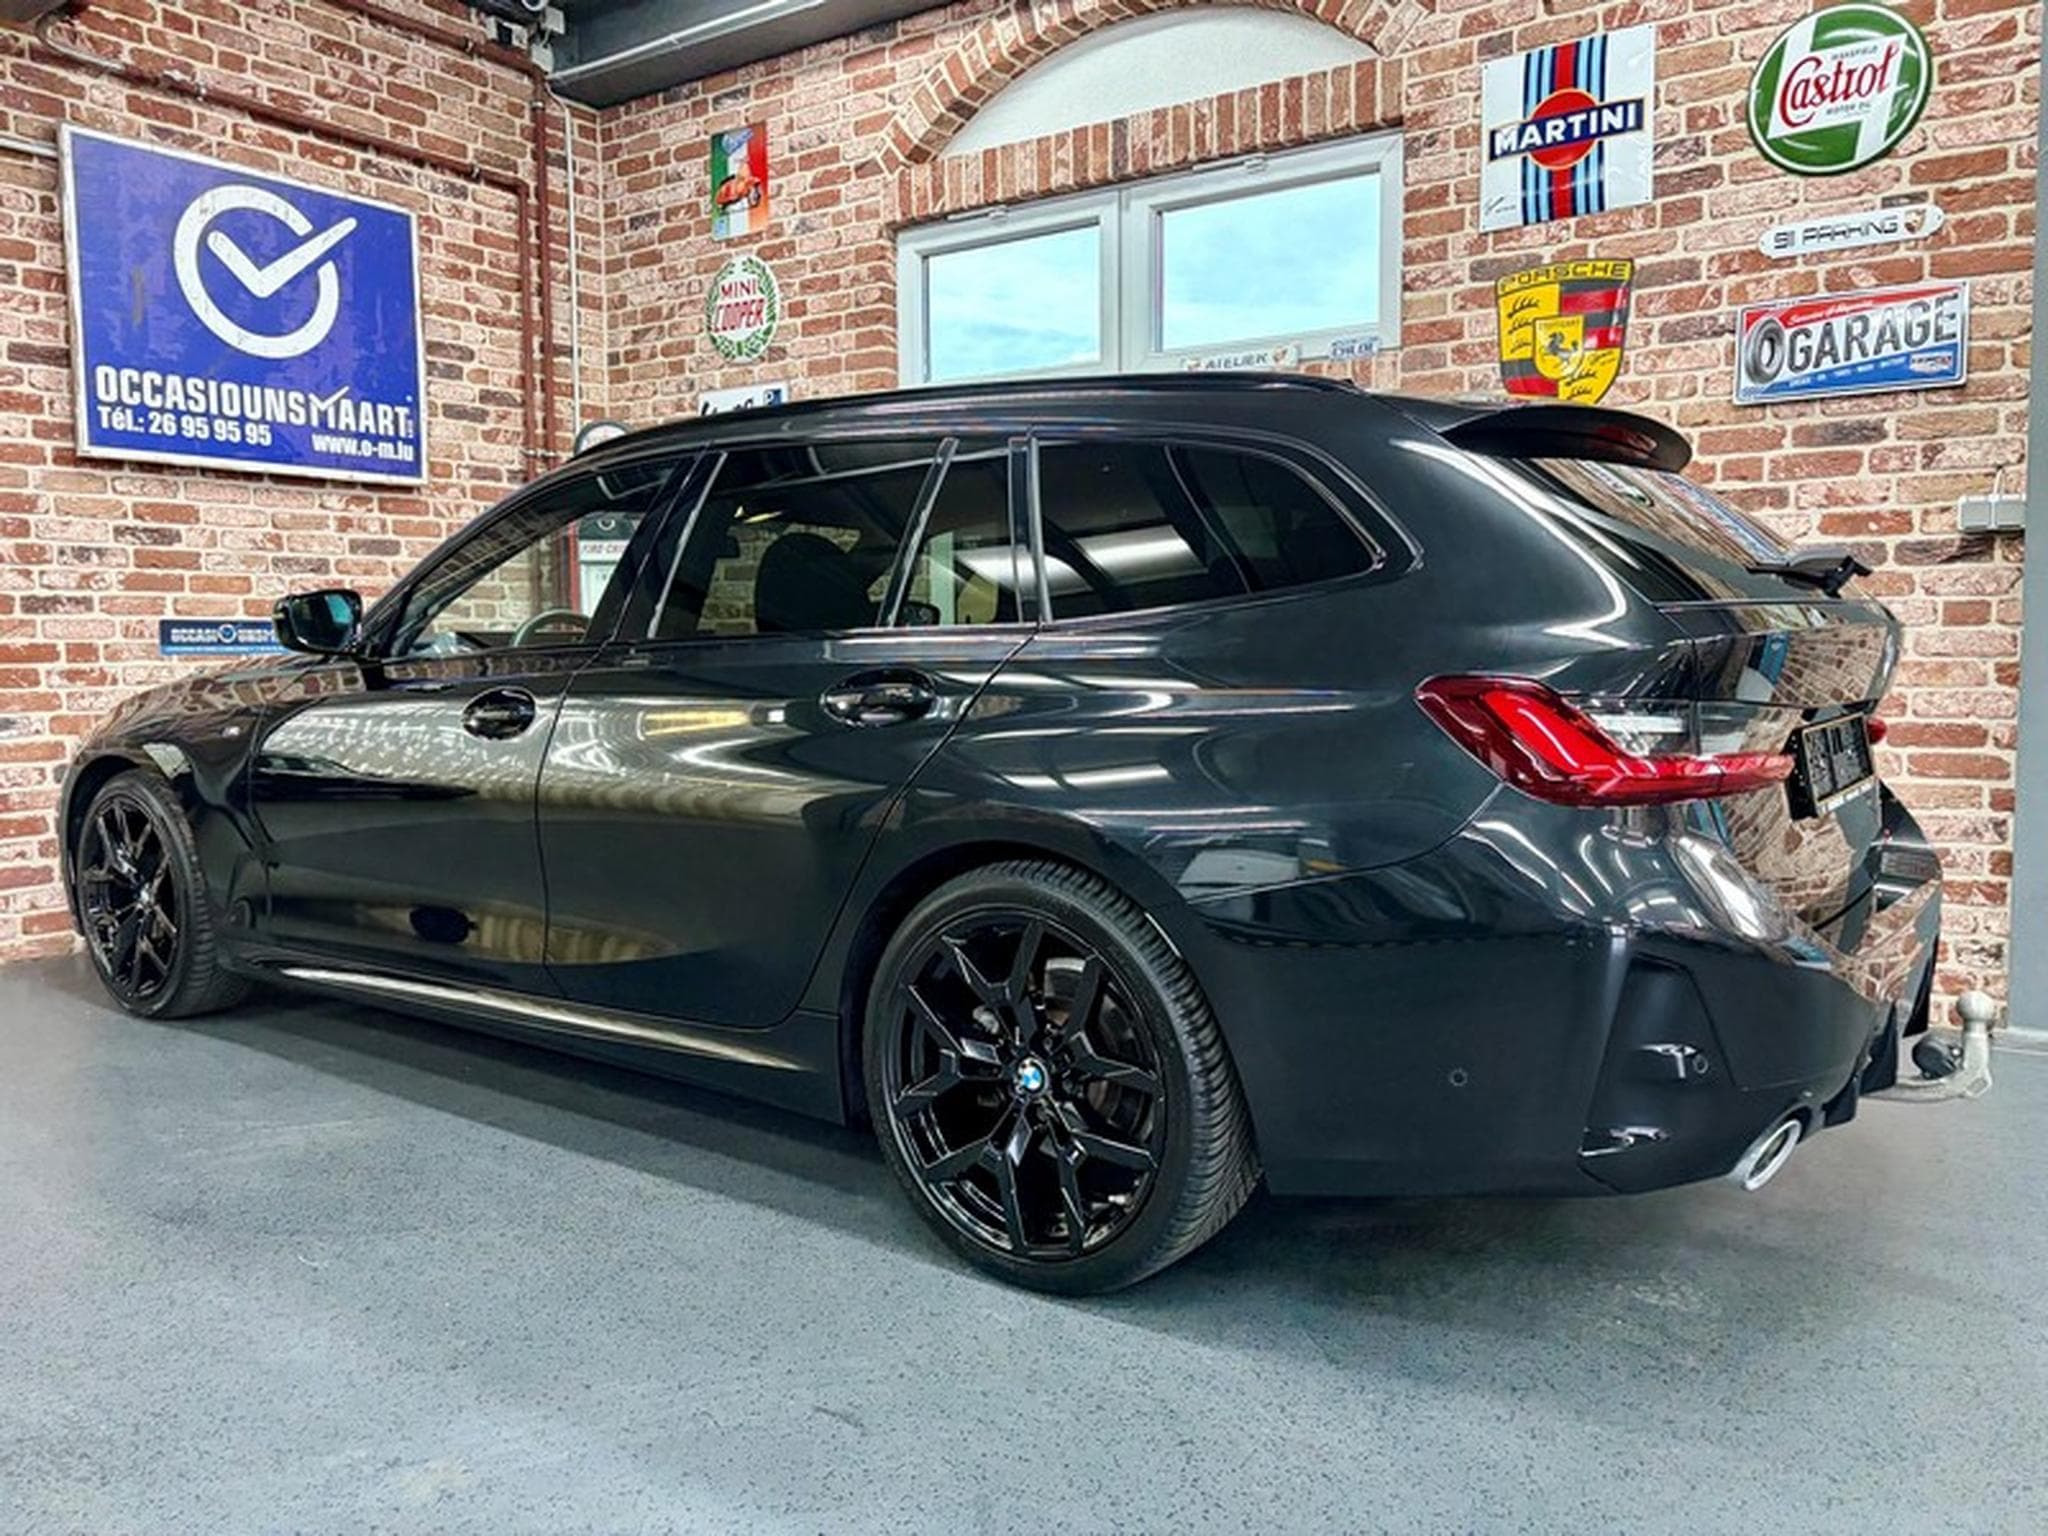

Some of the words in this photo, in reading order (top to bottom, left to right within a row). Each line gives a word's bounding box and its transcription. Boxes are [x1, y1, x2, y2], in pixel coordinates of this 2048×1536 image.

[1779, 40, 1899, 128] Castrol
[1494, 102, 1637, 157] MARTINI
[1802, 215, 1899, 247] PARKING
[721, 278, 757, 298] MINI
[1499, 261, 1629, 292] PORSCHE
[714, 298, 764, 333] COOPER
[148, 411, 178, 437] 26
[181, 414, 210, 441] 95
[213, 418, 242, 444] 95
[244, 422, 273, 447] 95
[311, 432, 415, 462] www.o-m.lu
